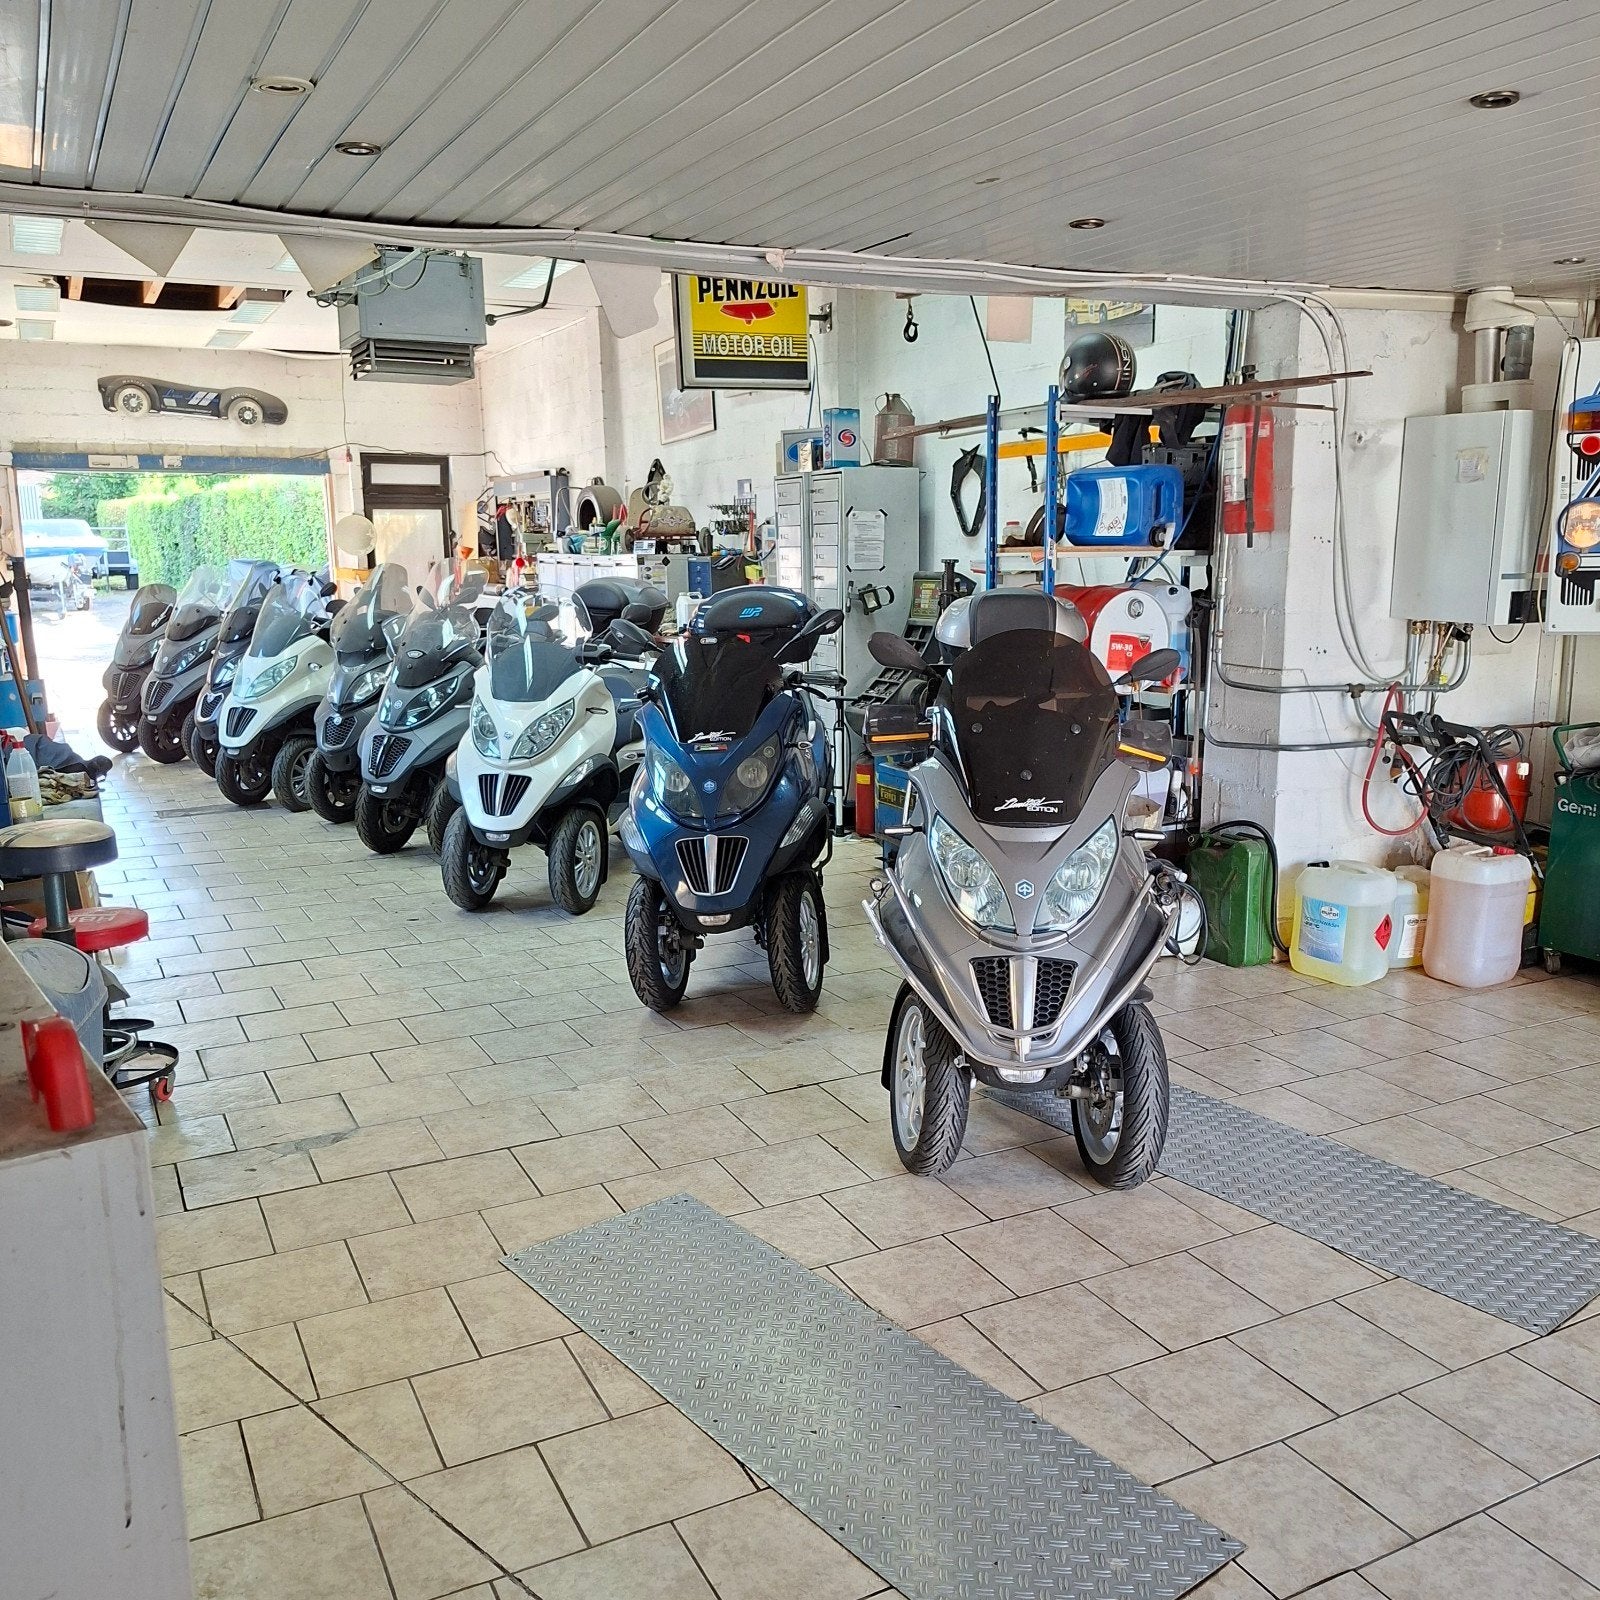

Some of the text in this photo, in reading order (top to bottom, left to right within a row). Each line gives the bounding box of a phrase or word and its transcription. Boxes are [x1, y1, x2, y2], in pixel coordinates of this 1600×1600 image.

[702, 333, 798, 357] MOTOR OIL
[1110, 642, 1133, 651] 5W-30
